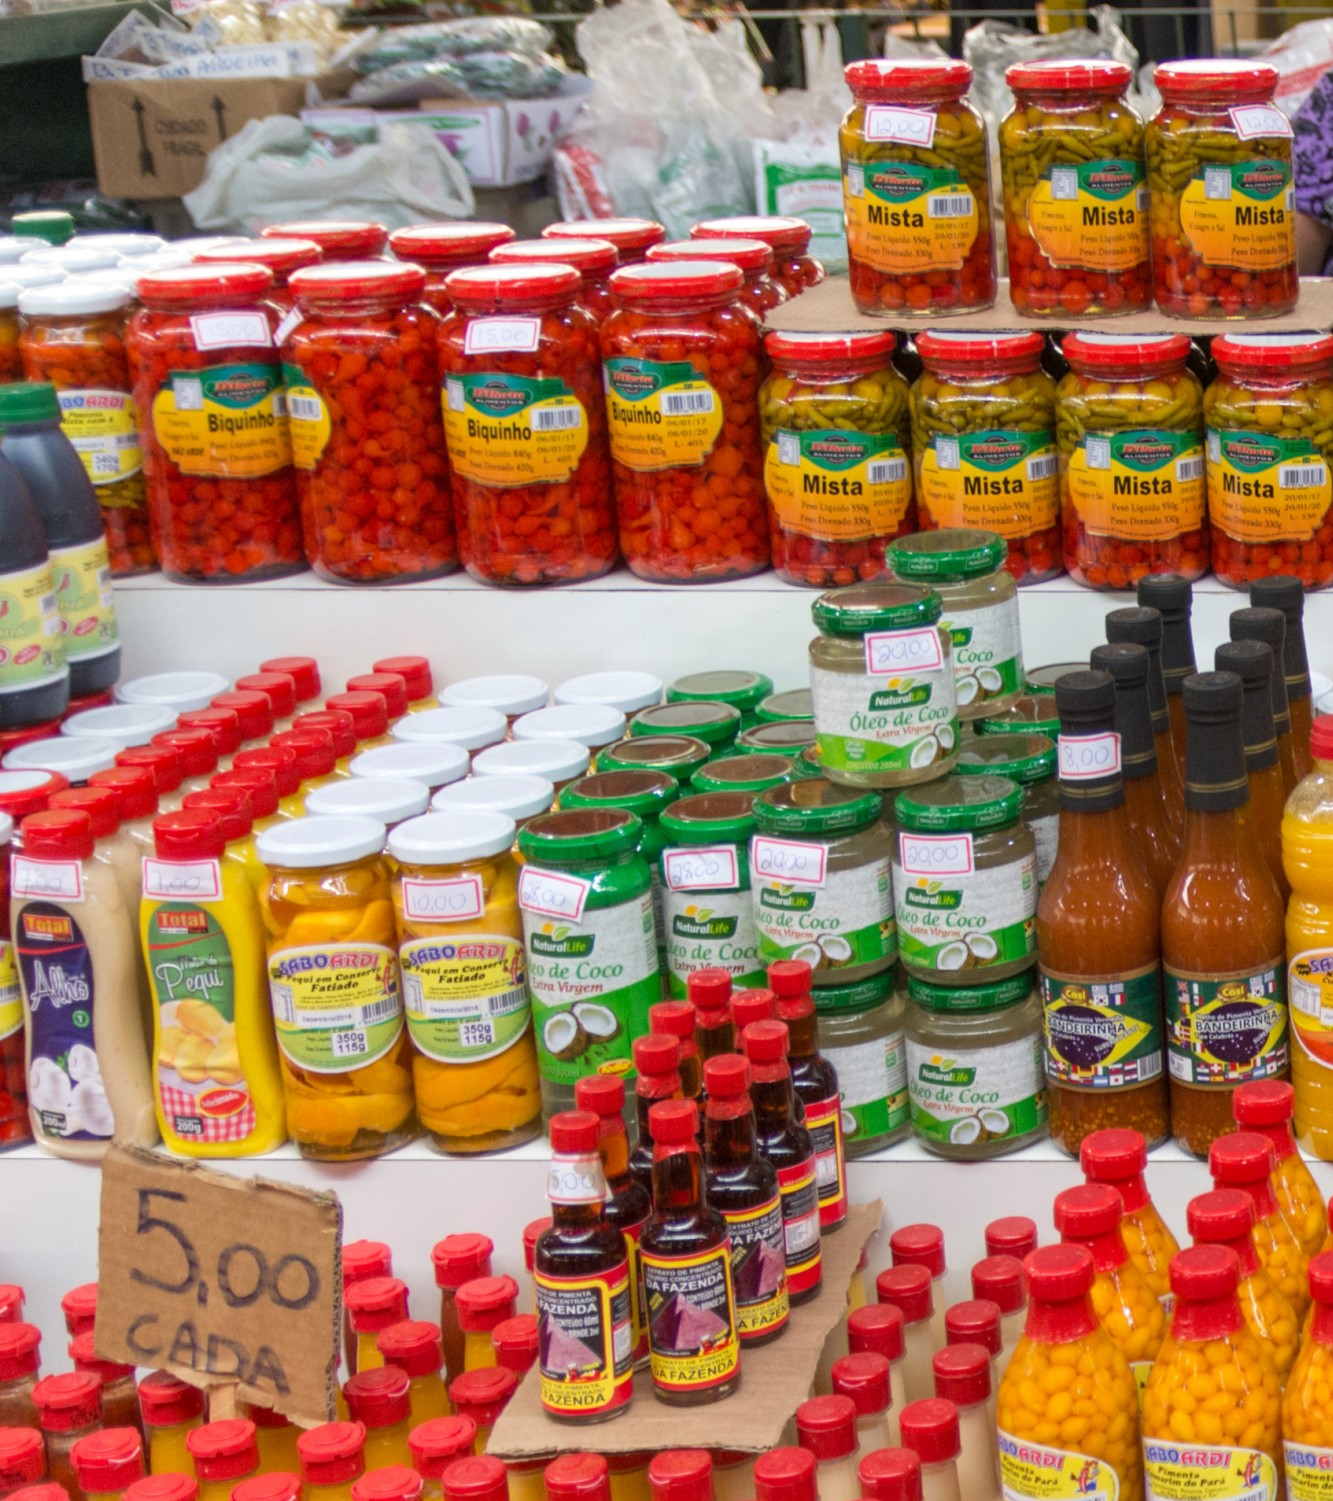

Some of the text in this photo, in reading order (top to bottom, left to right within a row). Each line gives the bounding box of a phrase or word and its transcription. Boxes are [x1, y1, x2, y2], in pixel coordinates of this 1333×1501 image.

[868, 207, 923, 227] Mista
[1082, 205, 1134, 226] Mista
[1235, 205, 1284, 226] Mista
[208, 412, 274, 434] Biquinho
[612, 403, 662, 427] Biquinho
[468, 418, 531, 443] Biquinho
[803, 474, 863, 496] Mista
[963, 475, 1024, 496] Mista
[1113, 475, 1171, 495] Mista
[1222, 473, 1274, 498] Mista
[875, 687, 927, 706] NaturalLife
[850, 705, 949, 732] Óleo de Coco
[26, 917, 69, 934] Total
[159, 911, 205, 927] Total
[279, 951, 380, 975] SABOARDI
[409, 943, 508, 966] SABOARDI
[155, 962, 224, 999] Pequi
[438, 972, 486, 985] Fatiado
[576, 961, 624, 979] Coco
[310, 981, 359, 994] Fatiado
[558, 981, 604, 995] Virgem
[1064, 989, 1086, 1001] Casi
[463, 1024, 492, 1037] 350g
[1196, 1010, 1278, 1032] BANDEIRINHA
[336, 1032, 365, 1045] 350g
[337, 1042, 366, 1055] 115g
[962, 1090, 1000, 1104] Coco
[646, 1272, 724, 1293] DA FAZENDA
[540, 1303, 597, 1315] FAZENDA
[126, 1313, 291, 1397] CADA
[676, 1357, 735, 1382] FAZENDA
